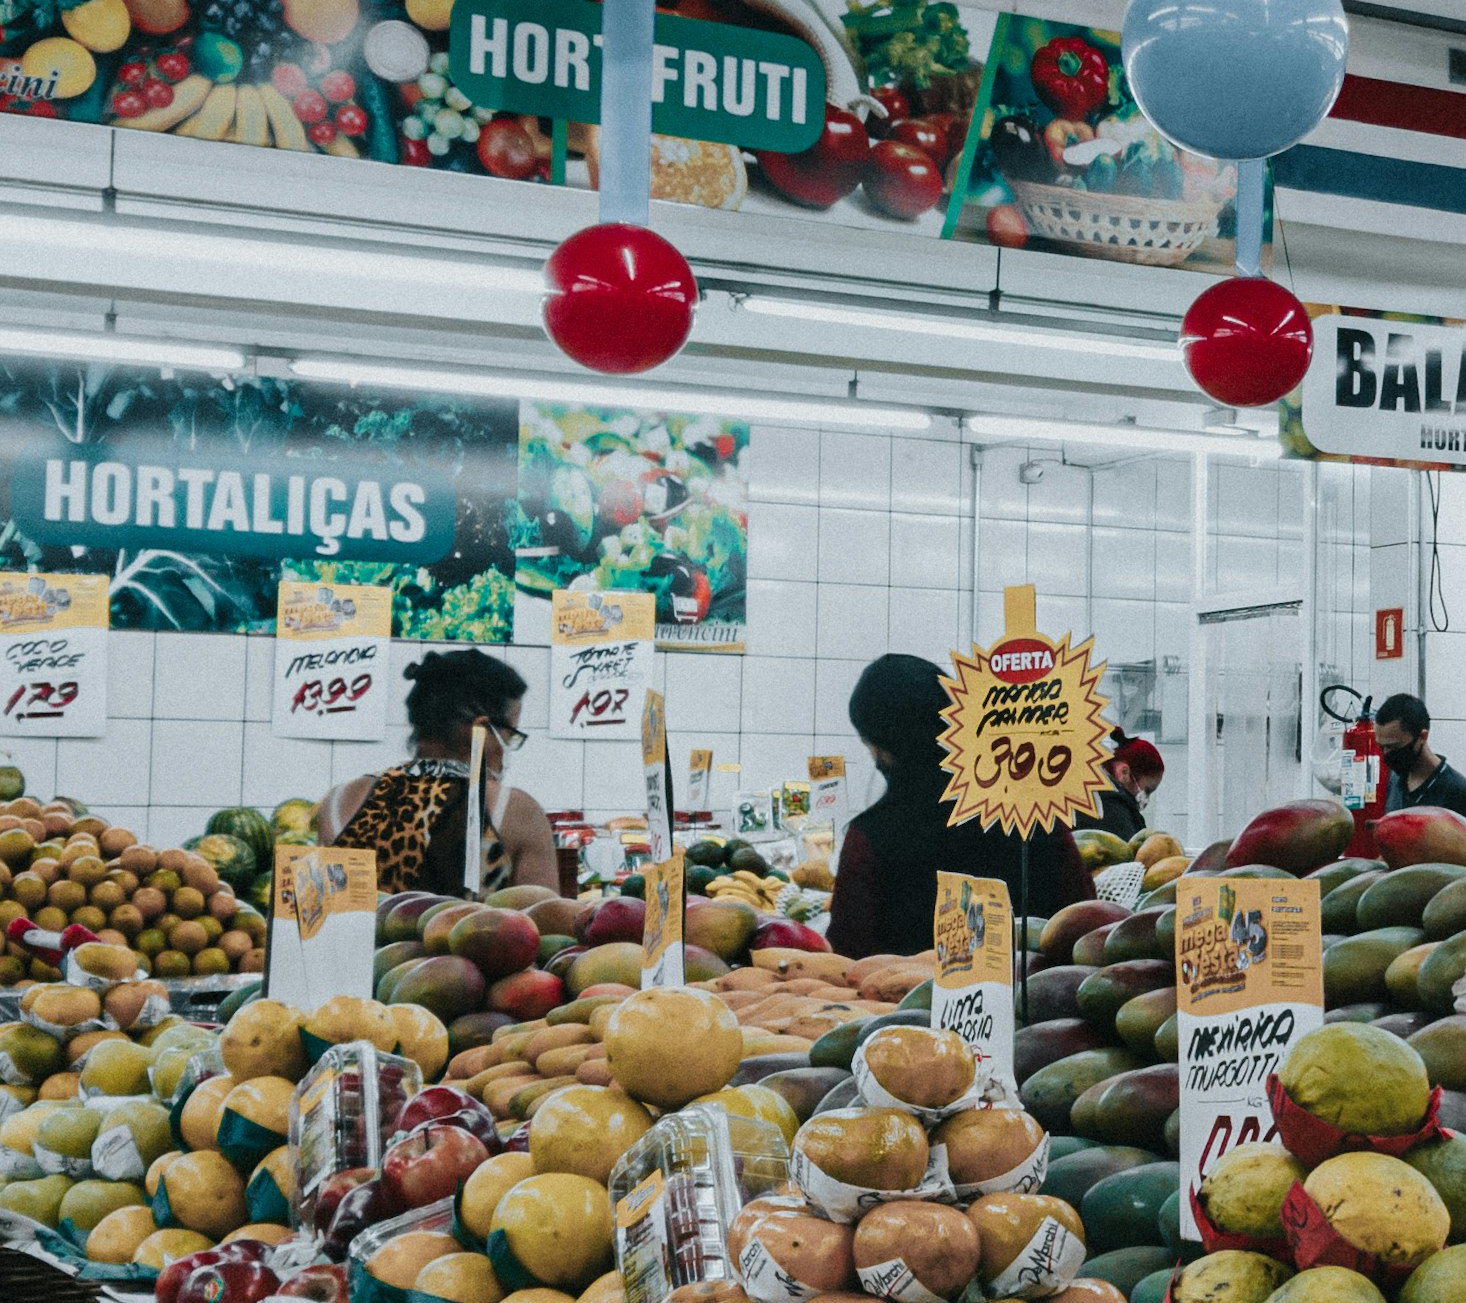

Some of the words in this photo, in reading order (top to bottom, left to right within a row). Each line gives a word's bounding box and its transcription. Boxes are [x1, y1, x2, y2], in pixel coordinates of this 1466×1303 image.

[44, 459, 426, 555] HORTALIÇAS
[285, 644, 379, 679] MELANCIA
[990, 650, 1054, 673] OFERTA
[1018, 1221, 1061, 1288] DeMarchi
